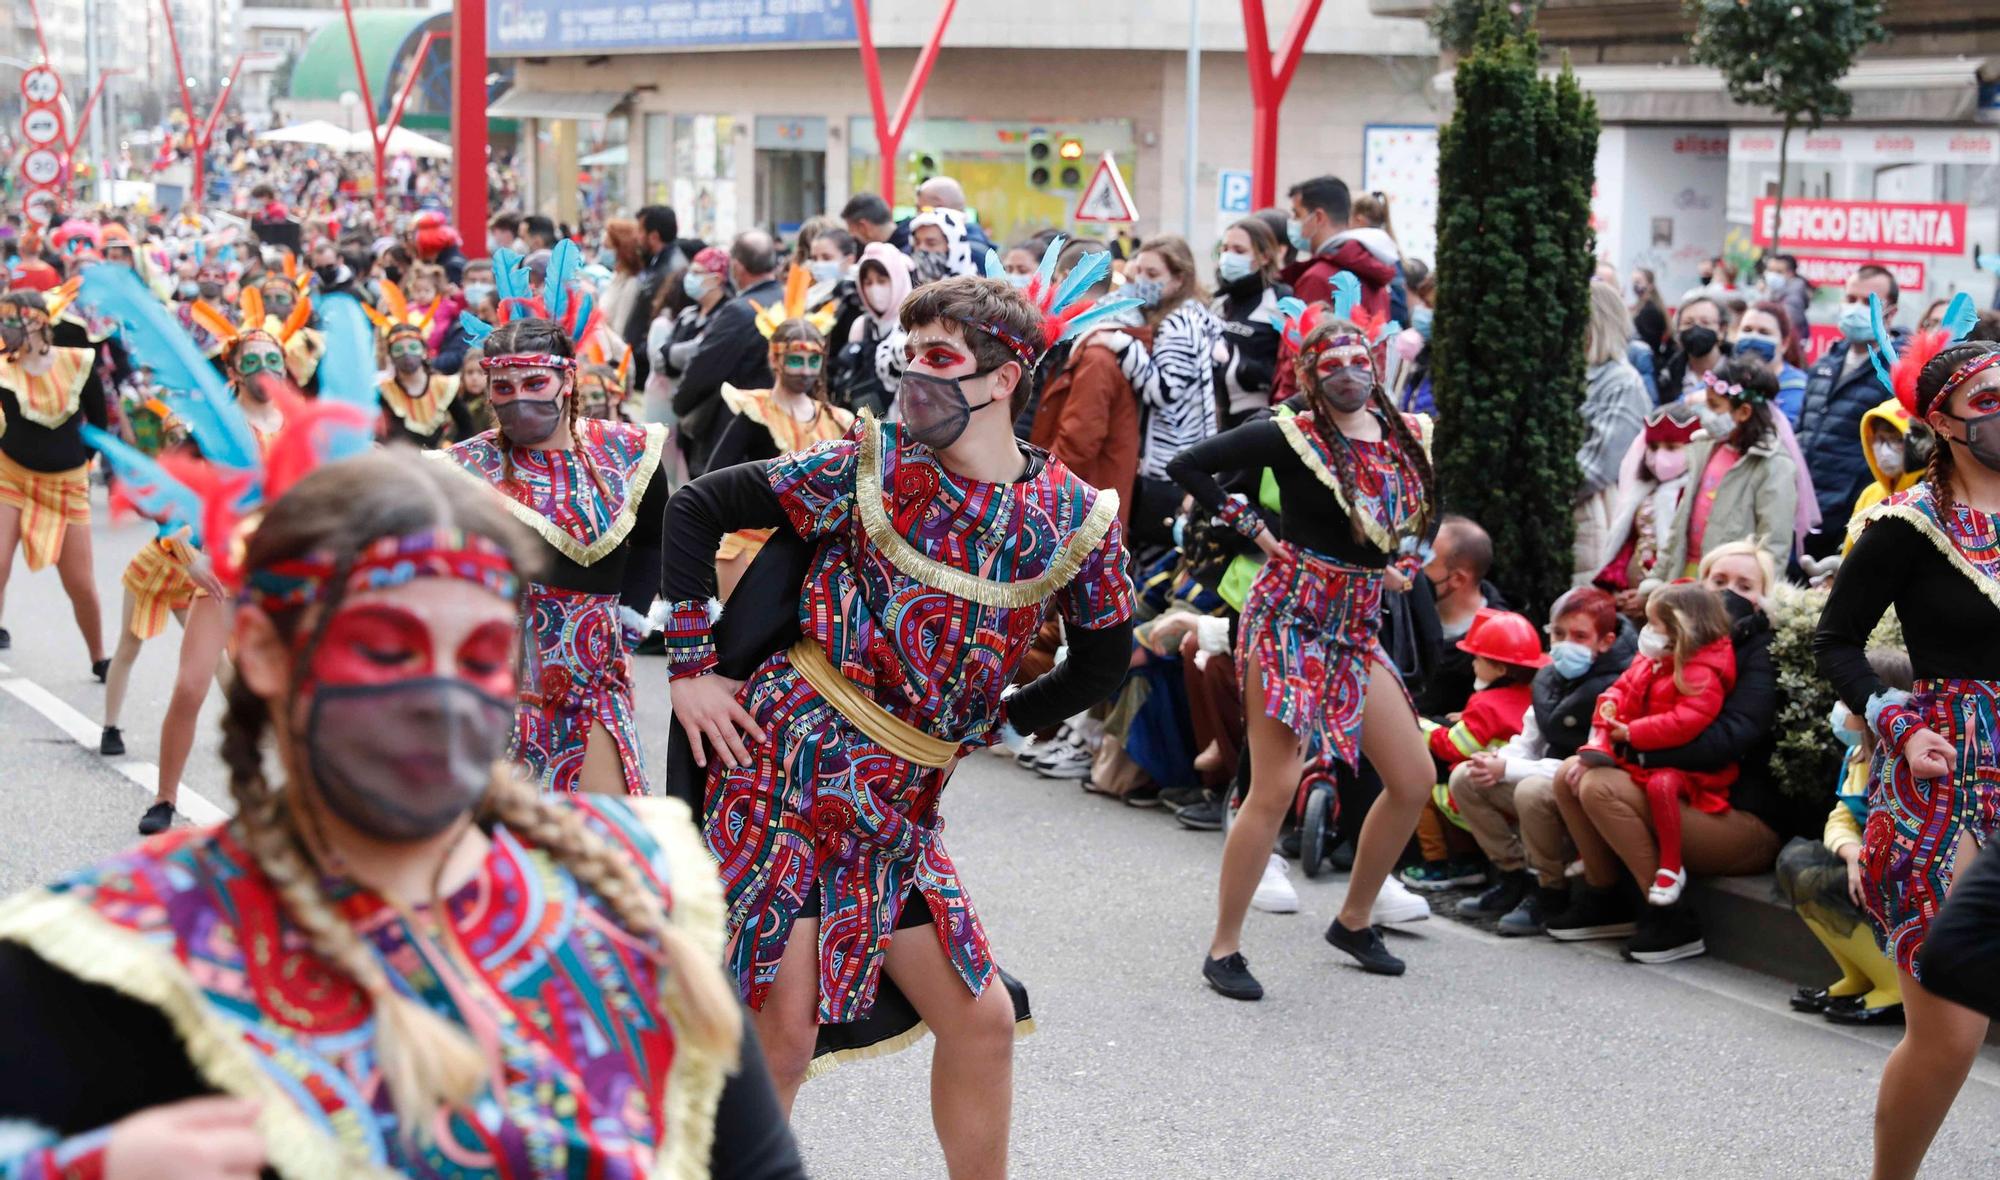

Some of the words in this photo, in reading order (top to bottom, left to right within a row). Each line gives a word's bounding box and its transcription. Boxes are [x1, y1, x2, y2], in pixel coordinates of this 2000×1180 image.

[1226, 176, 1249, 208] P
[1849, 208, 1880, 243] EN
[1879, 209, 1955, 248] VENTA
